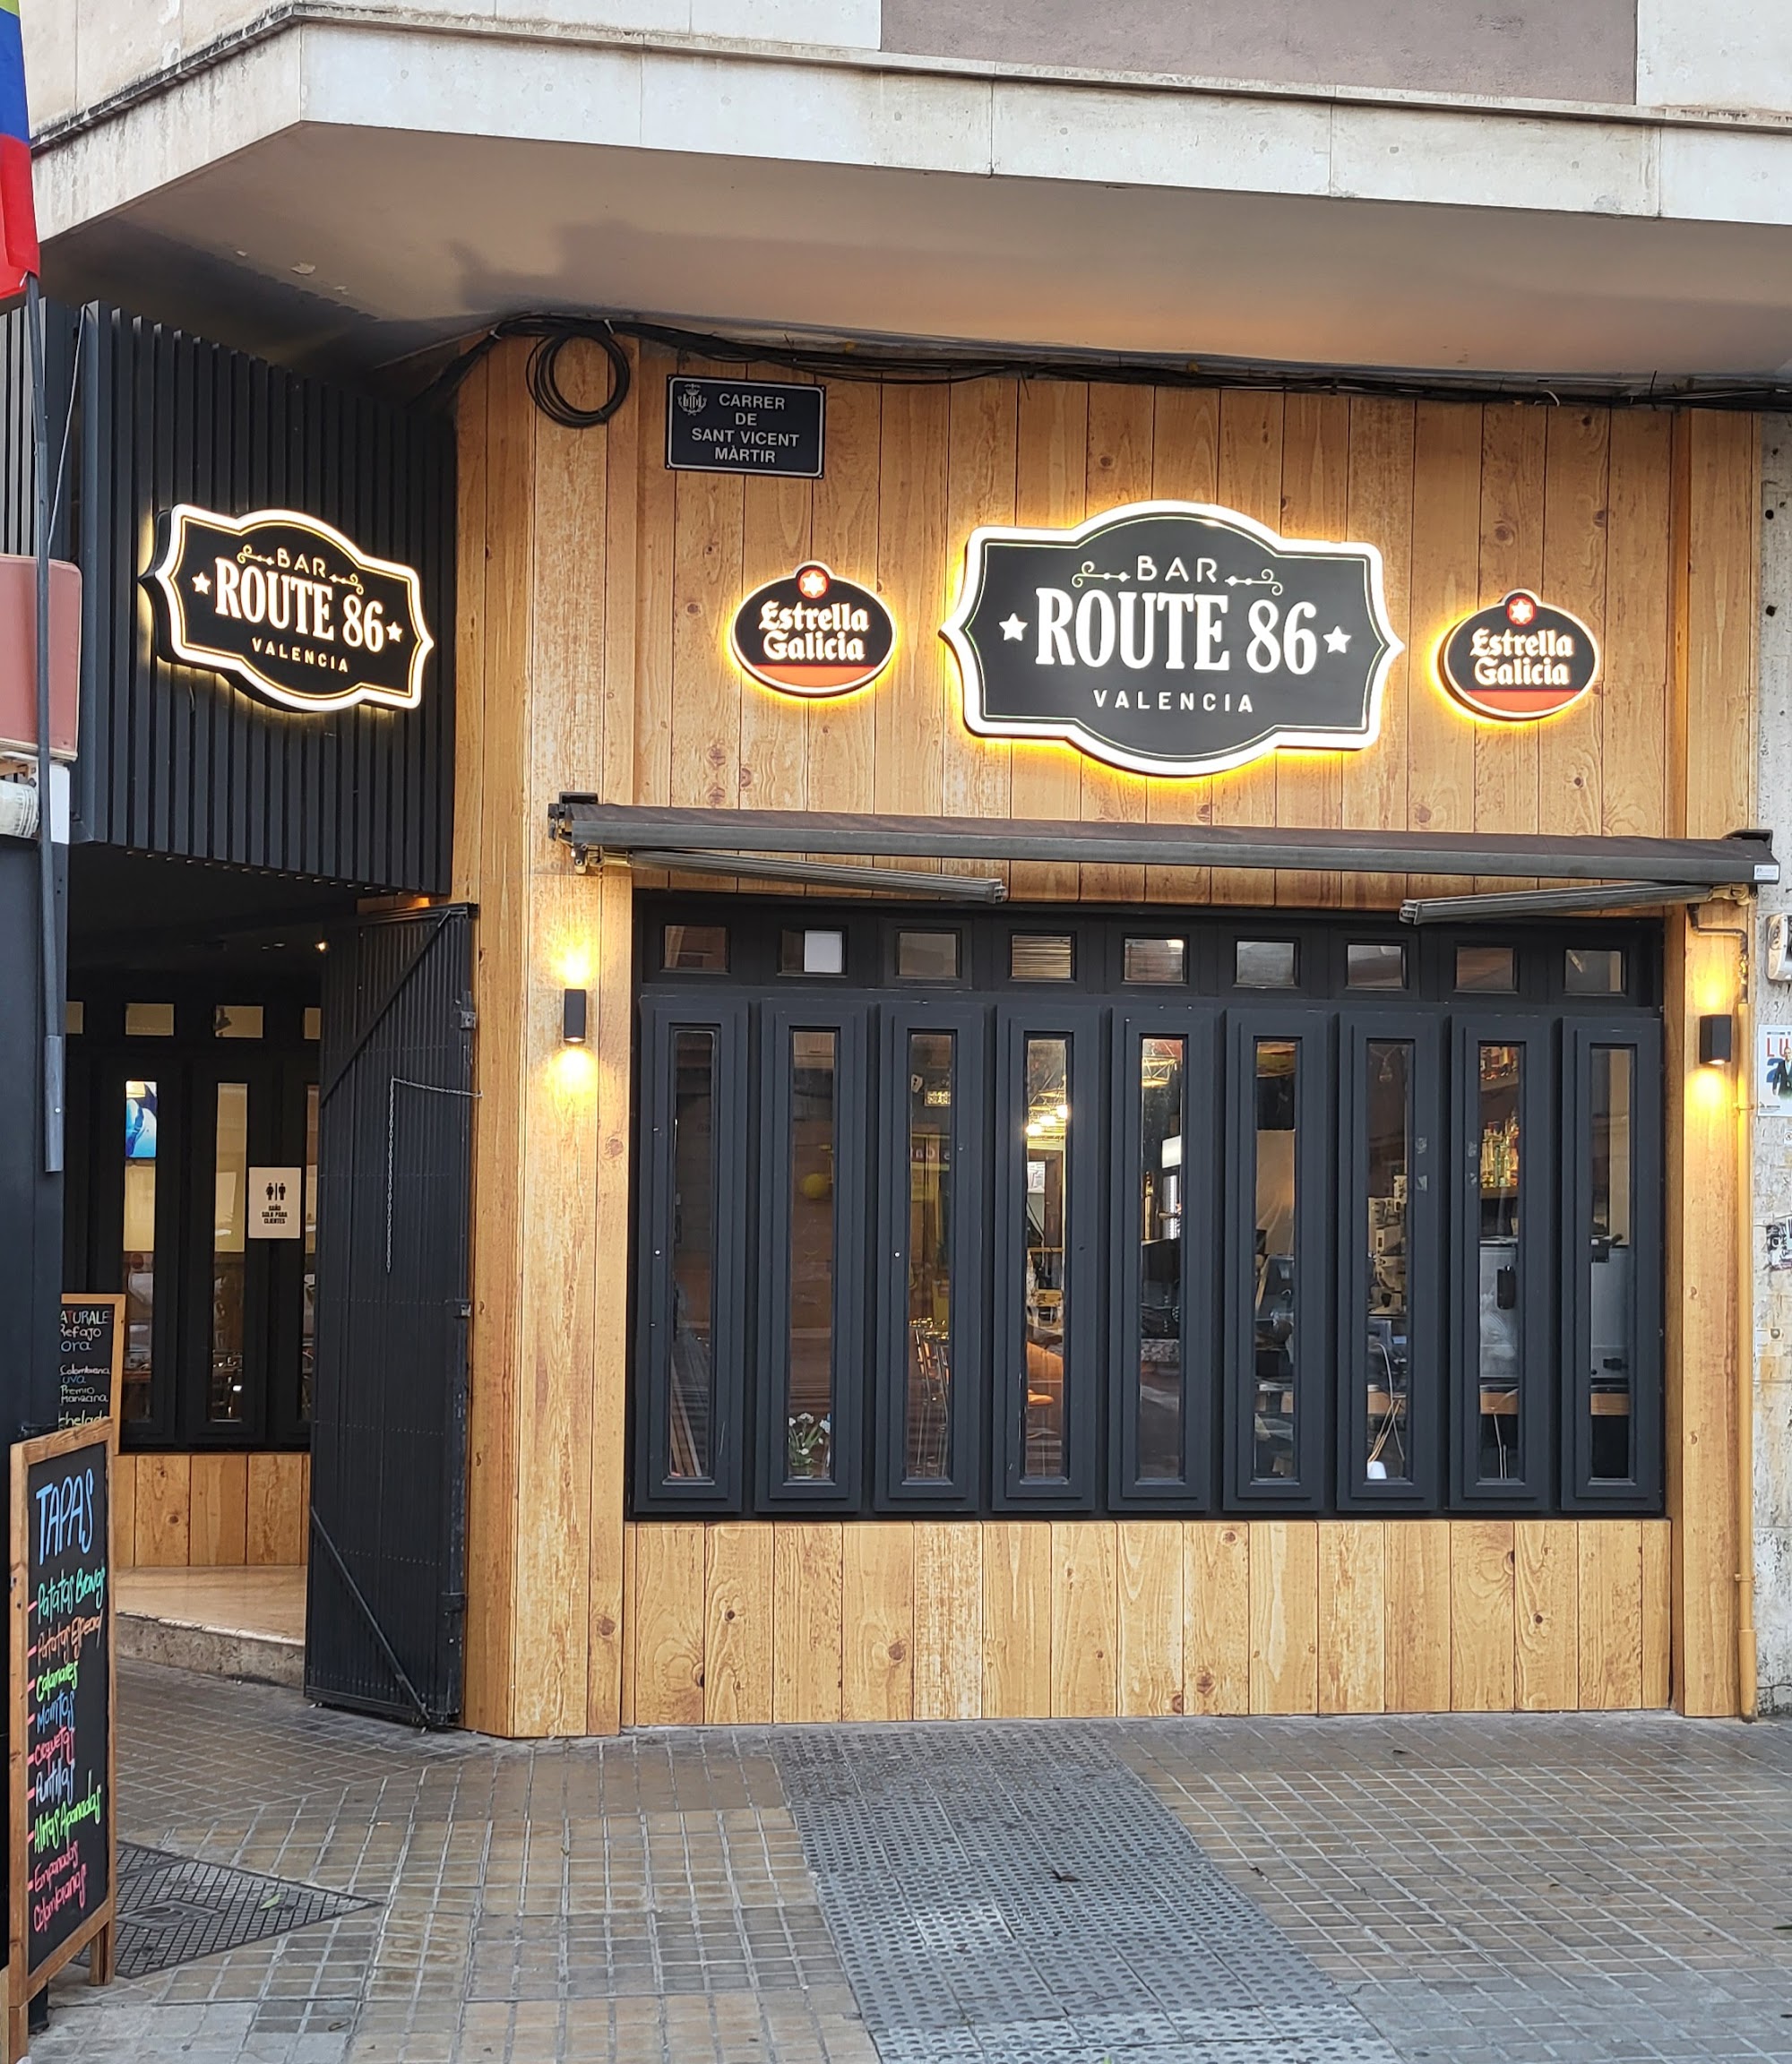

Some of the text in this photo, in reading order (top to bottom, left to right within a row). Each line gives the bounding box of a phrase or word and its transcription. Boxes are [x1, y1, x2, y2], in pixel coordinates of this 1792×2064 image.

[719, 392, 785, 410] CARRER
[735, 412, 757, 426] DE
[691, 427, 800, 447] SANT VICENT
[714, 444, 777, 463] MÀRTIR
[276, 547, 327, 579] BAR
[1136, 555, 1219, 583] BAR
[214, 556, 384, 653] ROUTE 86
[758, 599, 870, 632] Estrella
[762, 630, 866, 661] Galicia
[1034, 587, 1318, 675] ROUTE 86
[1469, 627, 1574, 658] Estrella
[252, 637, 349, 673] VALENCIA
[1474, 657, 1570, 686] Galicia
[1092, 688, 1254, 713] VALENCIA
[36, 1467, 94, 1566] TAPAS
[37, 1568, 74, 1625] Patatas
[37, 1621, 71, 1667] Patatas
[36, 1660, 79, 1702] Calamares
[34, 1839, 79, 1892] Empanadas
[33, 1862, 87, 1932] Colombianas
